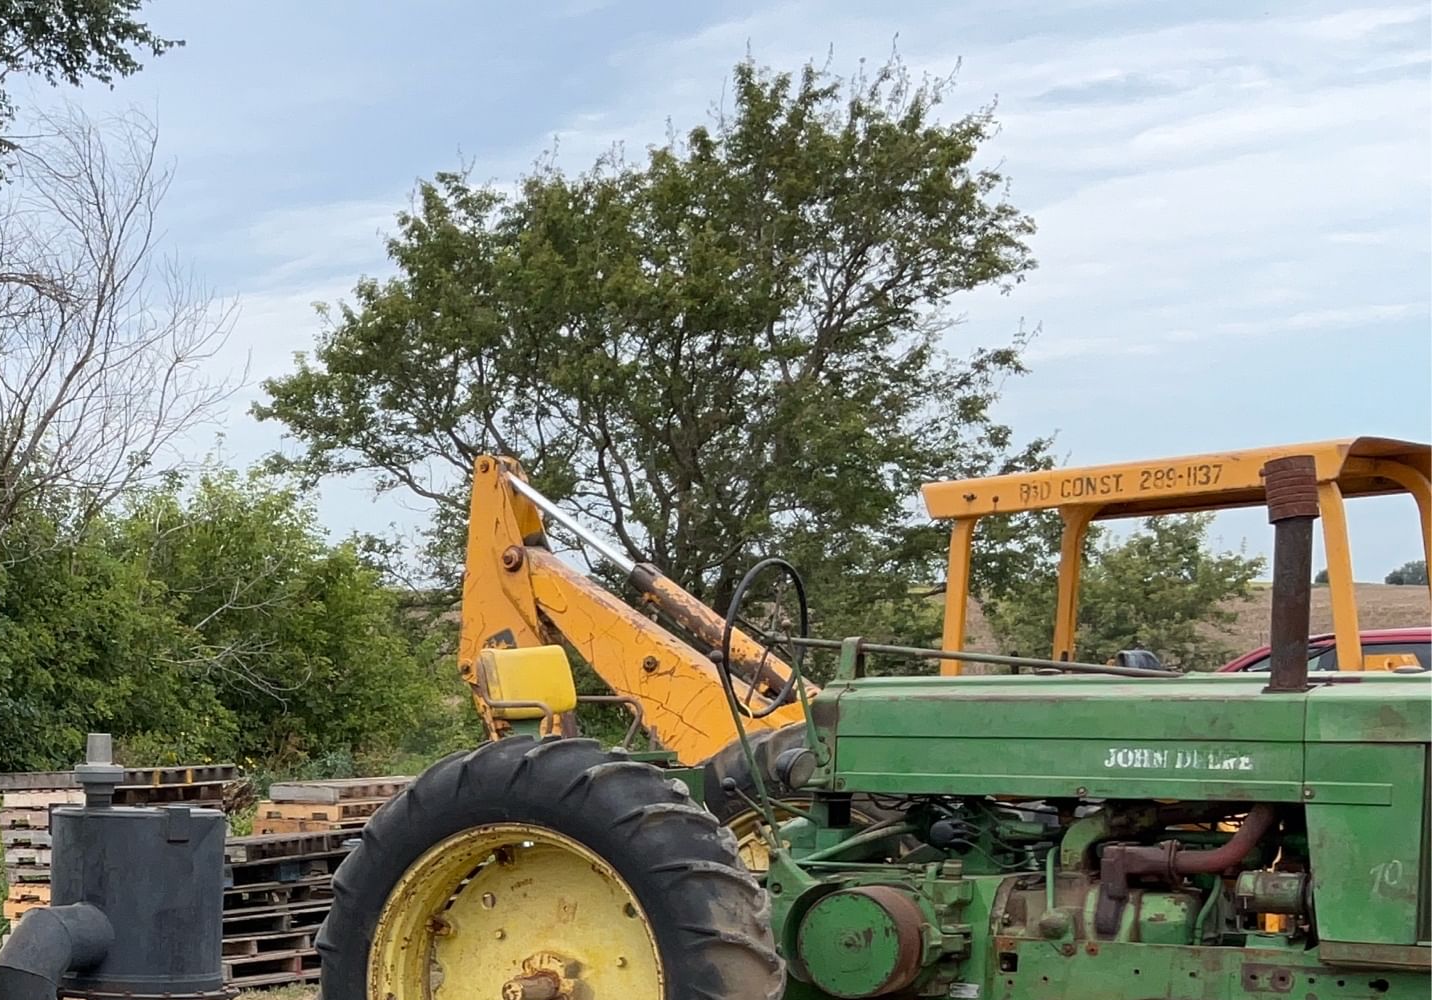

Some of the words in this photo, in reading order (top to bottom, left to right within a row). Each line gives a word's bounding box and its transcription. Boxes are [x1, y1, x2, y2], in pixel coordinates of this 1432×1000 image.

[1139, 464, 1223, 491] 289-1137
[1104, 748, 1169, 769] JOHN
[1369, 859, 1403, 893] 70
